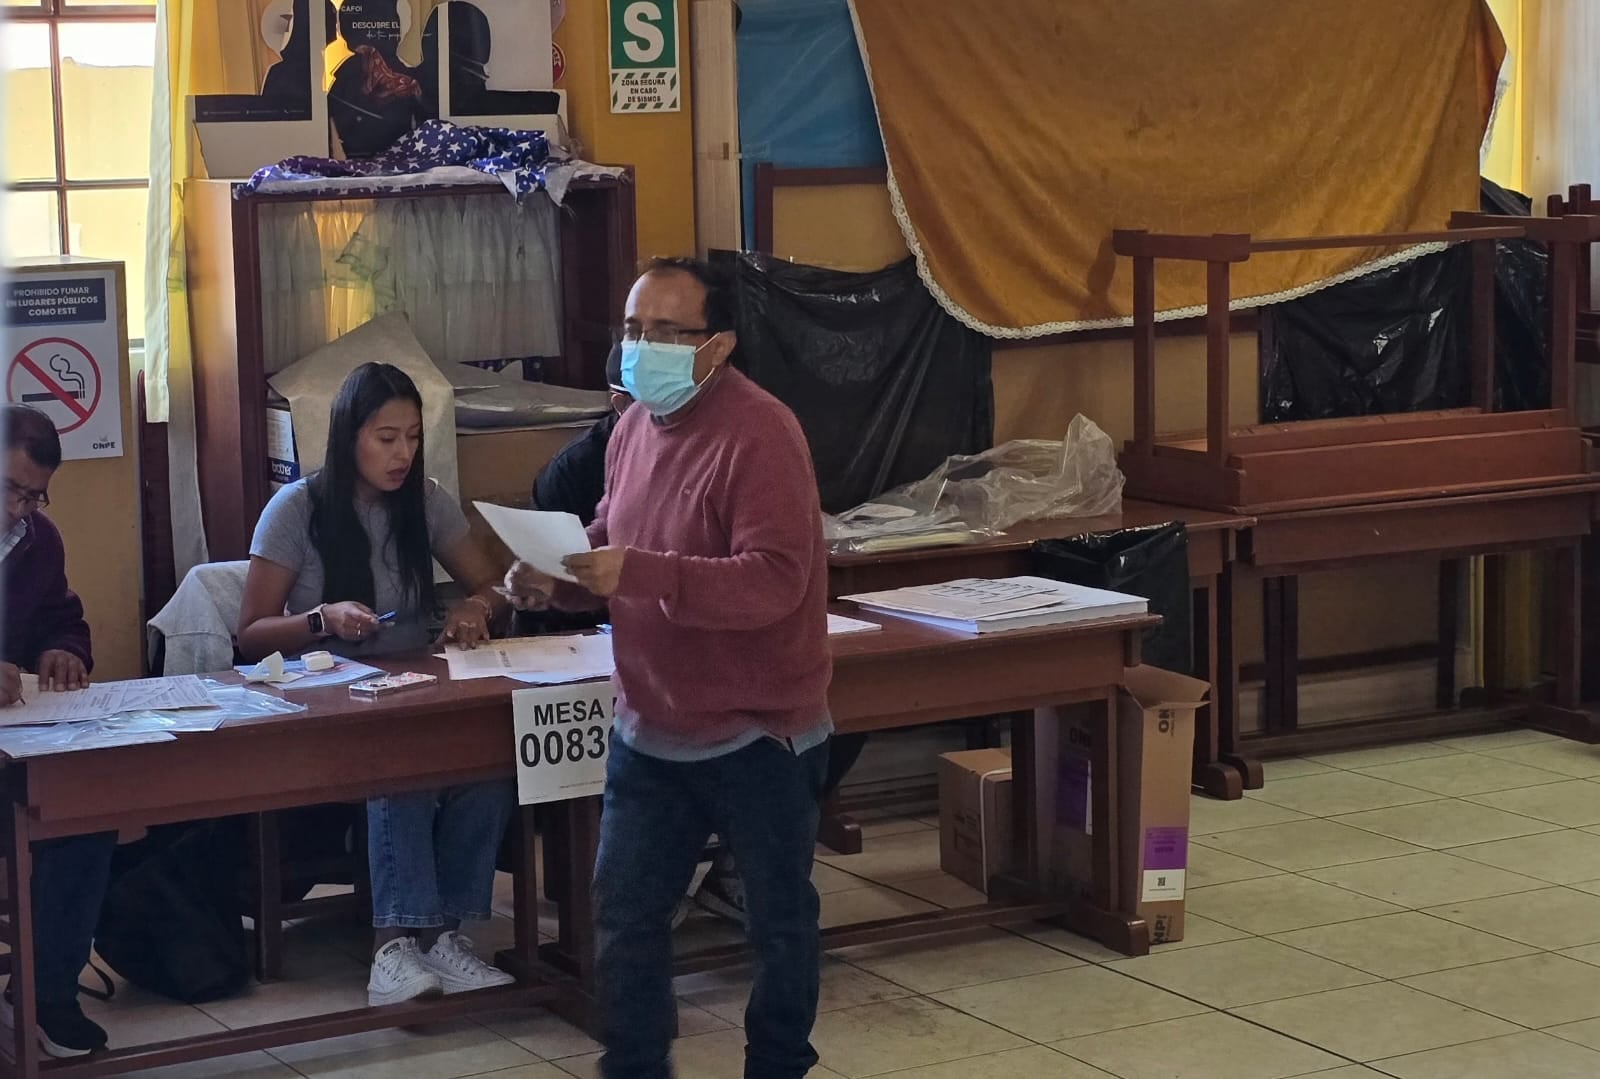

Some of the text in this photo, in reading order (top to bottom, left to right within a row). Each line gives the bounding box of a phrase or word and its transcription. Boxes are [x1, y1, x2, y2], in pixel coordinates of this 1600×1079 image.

[352, 21, 391, 29] DESCUBRE
[622, 1, 665, 63] S
[637, 95, 661, 103] SISMOS
[13, 286, 90, 297] PROHIBIDO FUMAR
[18, 298, 56, 307] LUGARES
[57, 295, 99, 305] PÚBLICOS
[28, 306, 77, 317] COMO ESTE
[92, 441, 116, 450] ONPE
[271, 461, 292, 476] brother
[533, 698, 605, 726] MESA
